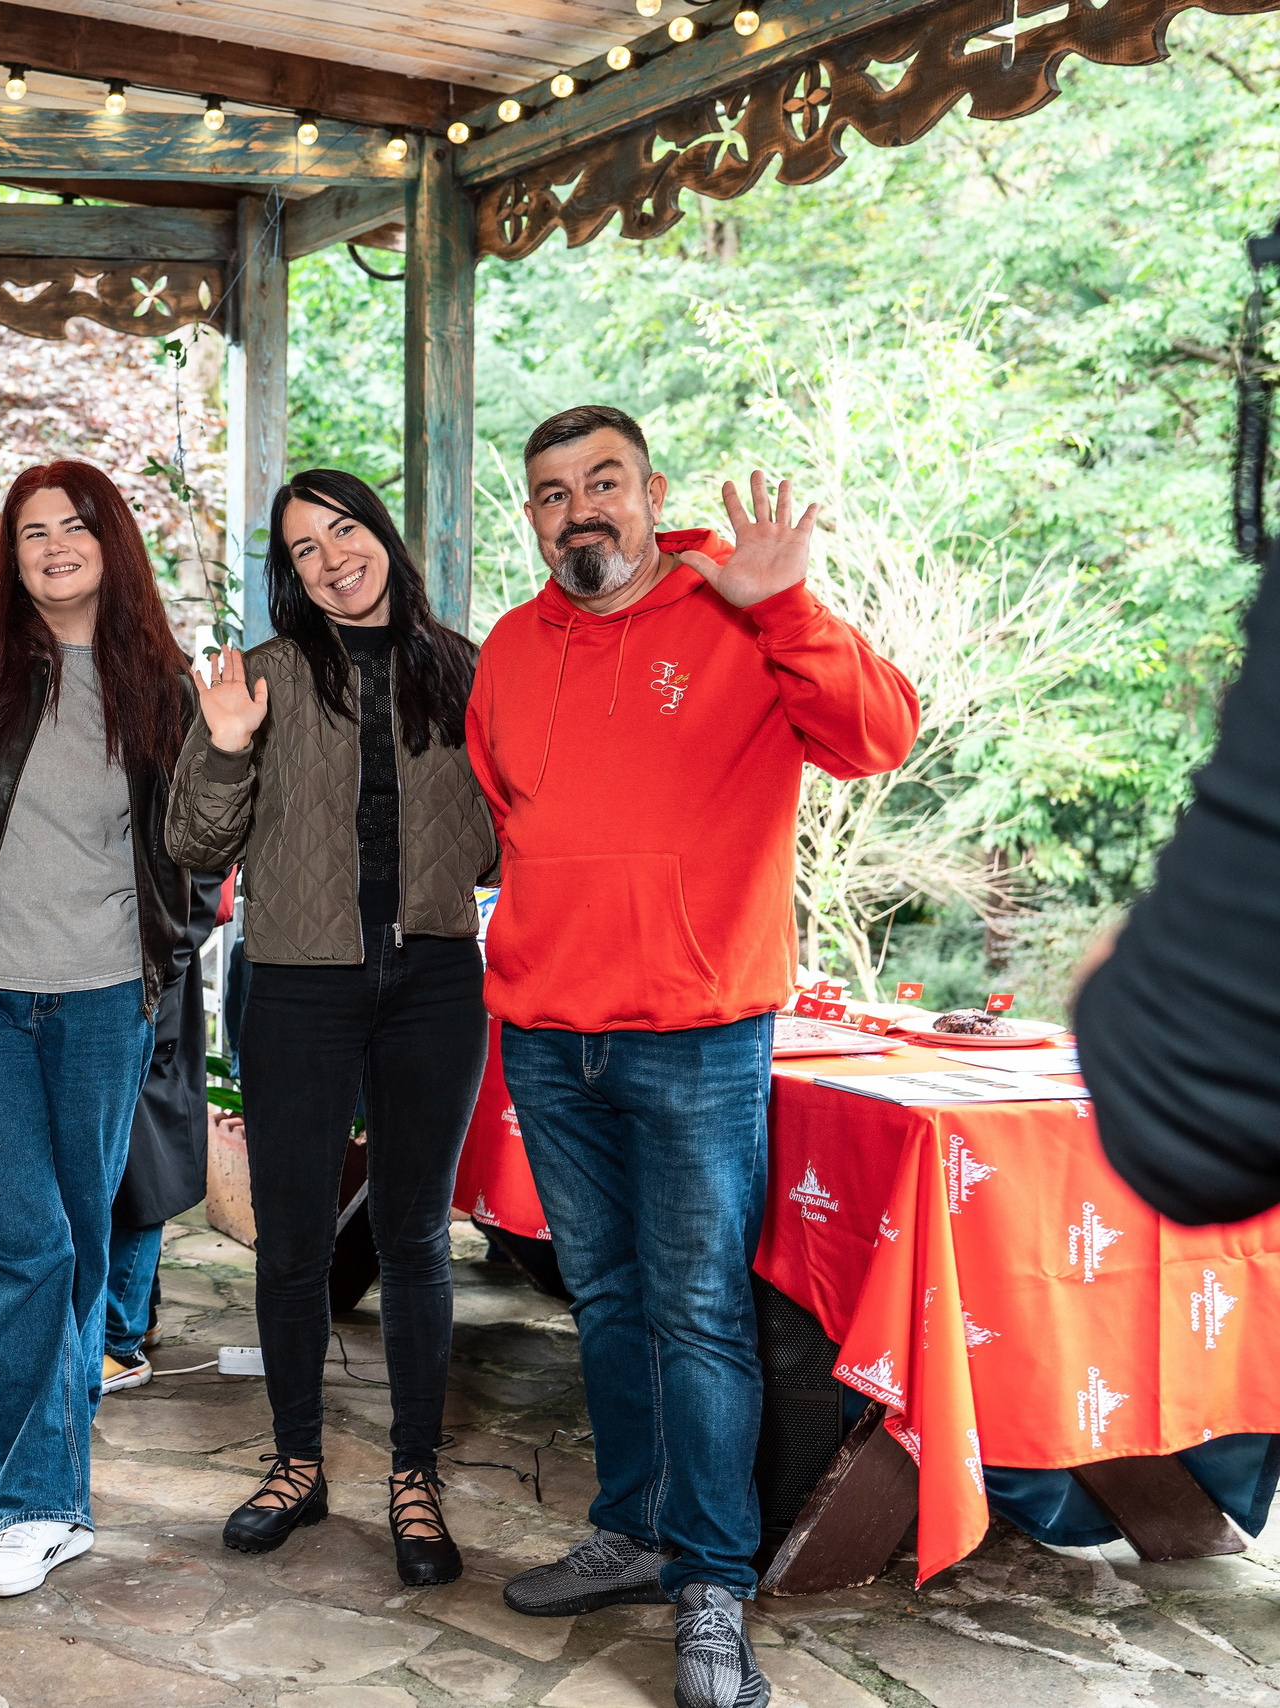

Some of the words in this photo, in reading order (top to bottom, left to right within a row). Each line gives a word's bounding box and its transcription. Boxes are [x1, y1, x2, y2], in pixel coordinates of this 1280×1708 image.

[948, 1134, 962, 1214] Открытый
[788, 1187, 839, 1212] Открытый
[801, 1205, 827, 1222] Огонь
[1068, 1224, 1081, 1266] Огонь
[1082, 1201, 1095, 1284] Открытый
[1190, 1292, 1202, 1332] Огонь
[1203, 1268, 1216, 1350] Открытый
[1077, 1390, 1088, 1431] Огонь
[1087, 1366, 1102, 1449] Открытый
